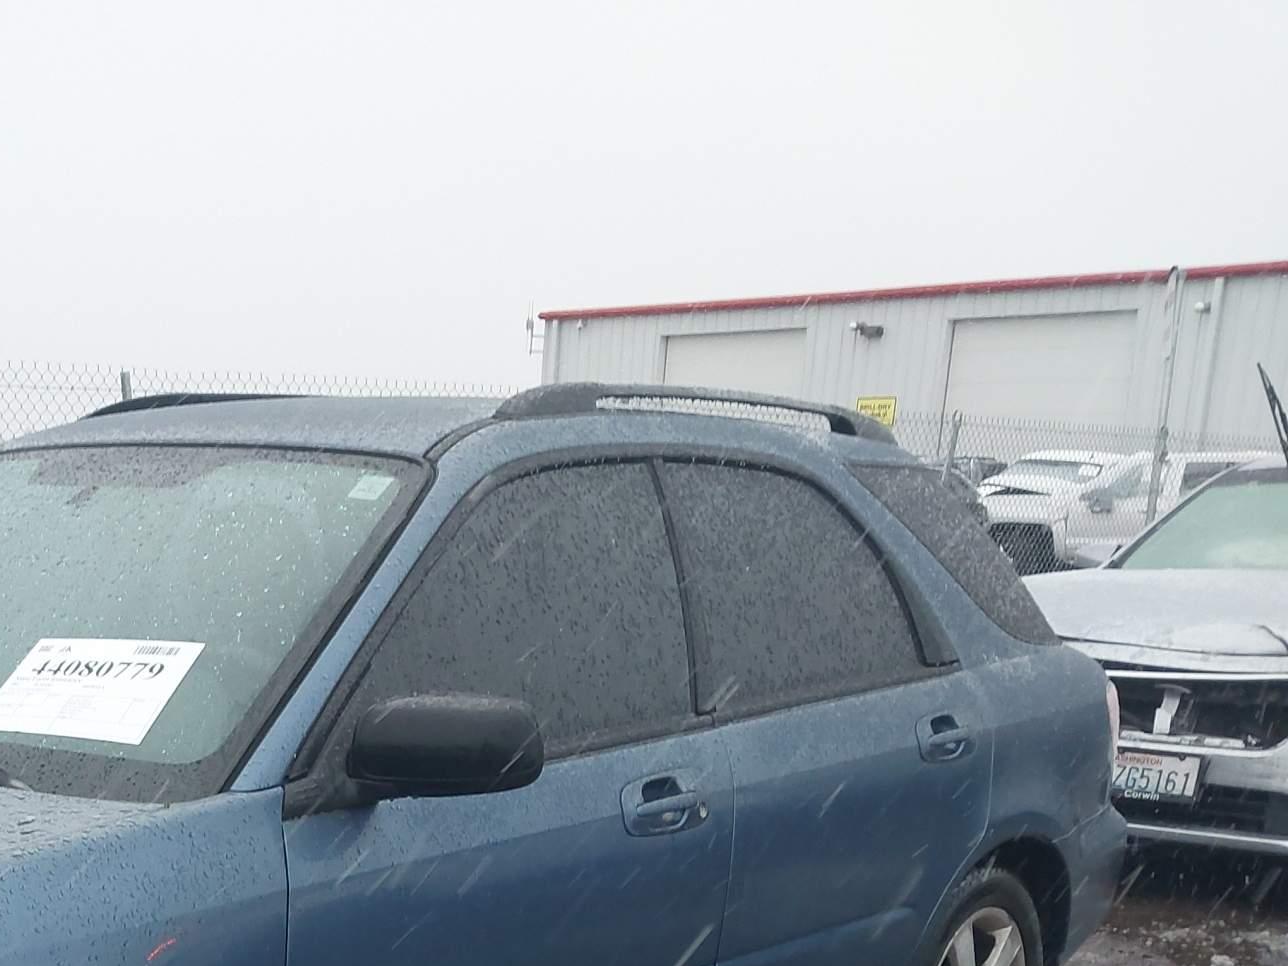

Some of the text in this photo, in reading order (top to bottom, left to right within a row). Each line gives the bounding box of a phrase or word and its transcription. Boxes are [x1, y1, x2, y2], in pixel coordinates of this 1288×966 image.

[32, 659, 165, 681] 44080779
[1115, 754, 1163, 767] ASHINGTON
[1113, 765, 1191, 797] ZG5161
[1124, 789, 1160, 801] Corwin
